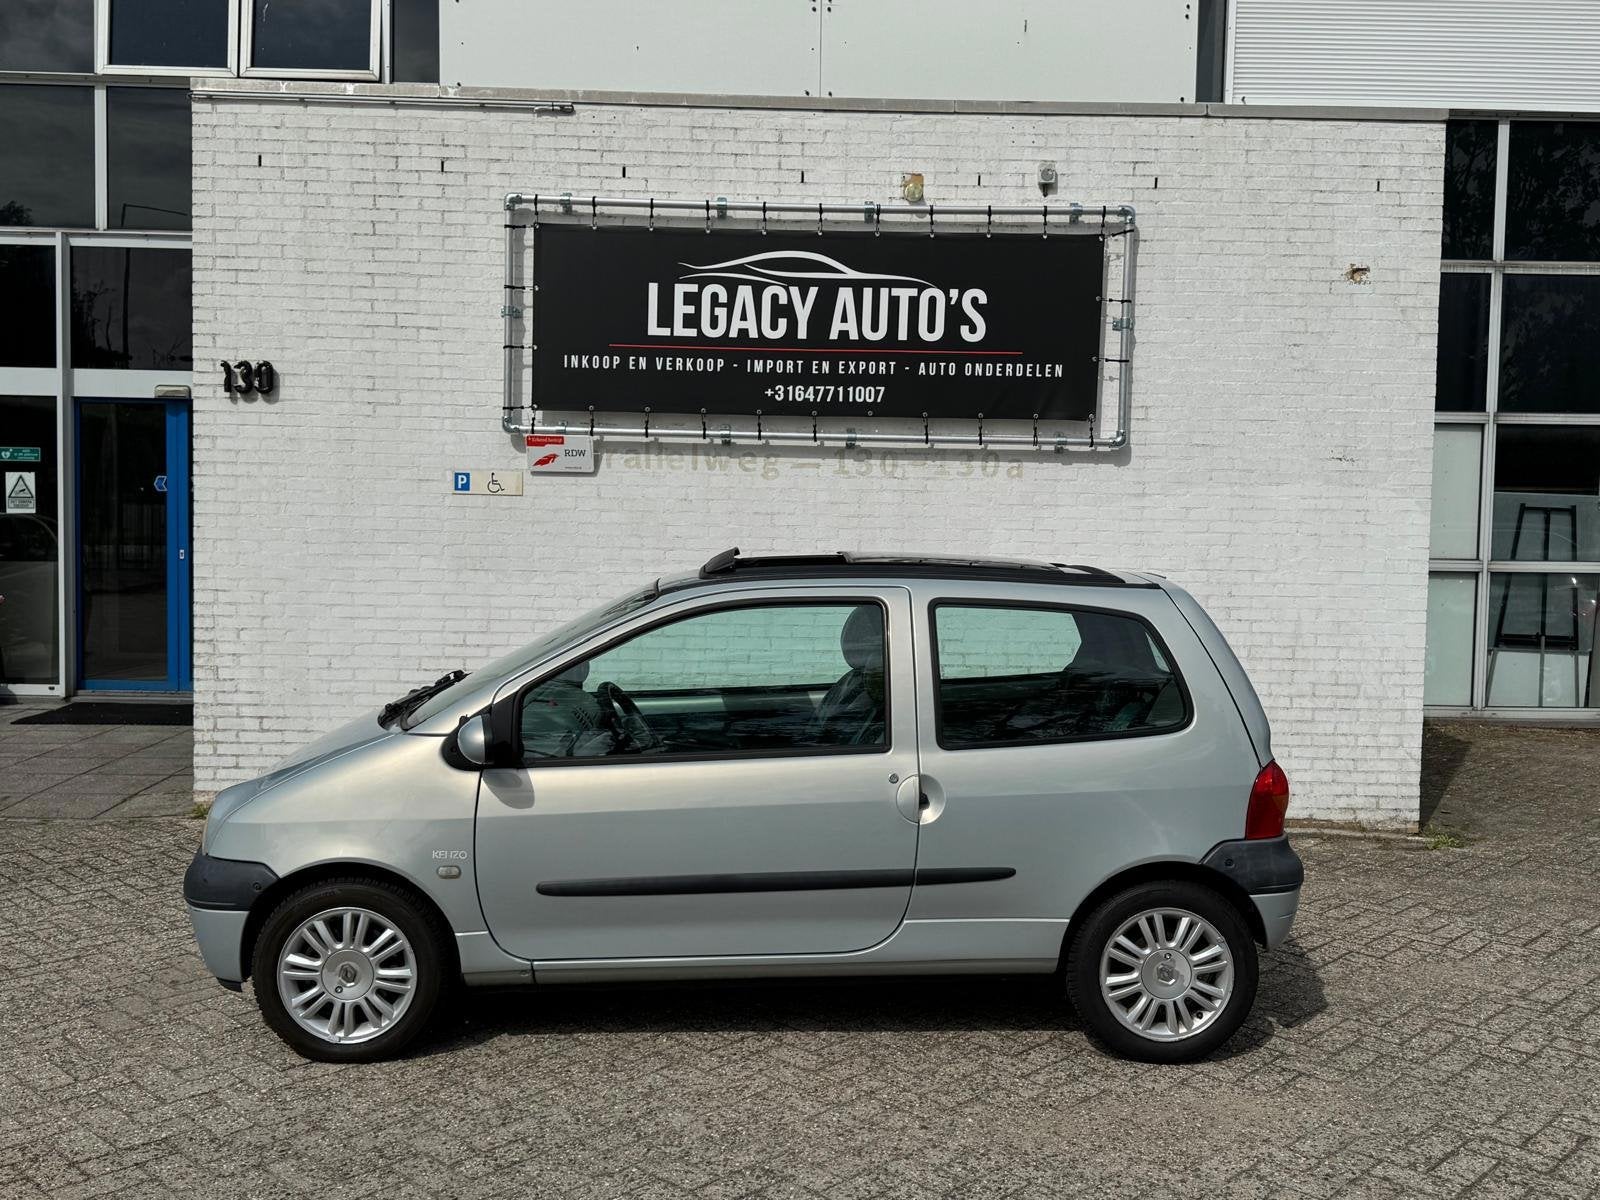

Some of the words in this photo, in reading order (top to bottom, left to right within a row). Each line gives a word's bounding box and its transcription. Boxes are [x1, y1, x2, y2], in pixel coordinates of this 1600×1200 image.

[647, 282, 820, 340] LEGACY
[828, 286, 988, 343] AUTO'S
[220, 360, 274, 394] 130
[563, 354, 622, 370] INKOOP
[628, 356, 648, 371] EN
[655, 356, 725, 373] VERKOOP
[746, 359, 804, 374] IMPORT
[811, 360, 830, 374] EN
[838, 360, 897, 375] EXPORT
[918, 362, 957, 377] AUTO
[964, 362, 1064, 379] ONDERDELEN
[764, 384, 886, 403] +31647711007
[564, 449, 586, 457] RDW
[604, 442, 780, 481] rallelweg
[457, 475, 467, 489] P
[432, 849, 468, 860] KENZO
